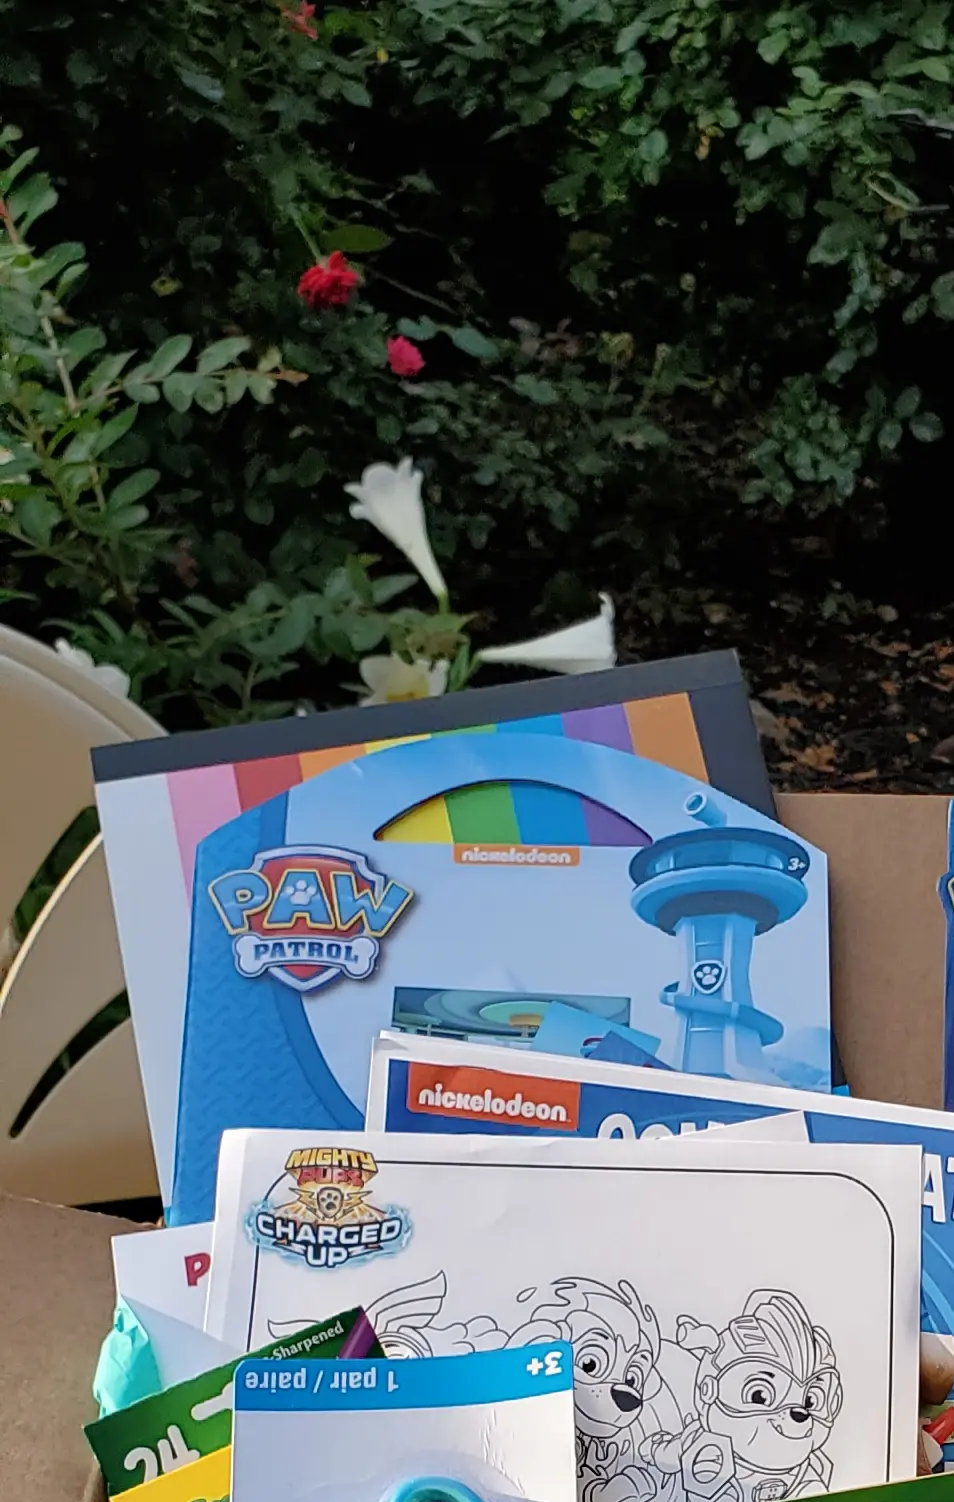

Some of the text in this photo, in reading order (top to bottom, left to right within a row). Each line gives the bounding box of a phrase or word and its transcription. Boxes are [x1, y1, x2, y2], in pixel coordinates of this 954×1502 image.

[461, 847, 571, 865] nickelodeon
[787, 857, 806, 872] 3+
[207, 868, 415, 937] PAW
[253, 940, 359, 964] PATROL
[418, 1083, 568, 1122] nickelodeon
[285, 1148, 377, 1173] MIGHTY
[297, 1166, 365, 1189] PUPS
[256, 1212, 402, 1245] CHARGED
[306, 1245, 350, 1268] UP
[526, 1353, 563, 1375] 3+
[245, 1366, 308, 1388] paire
[329, 1366, 377, 1388] pair
[387, 1370, 400, 1391] 1
[124, 1424, 201, 1484] 24
